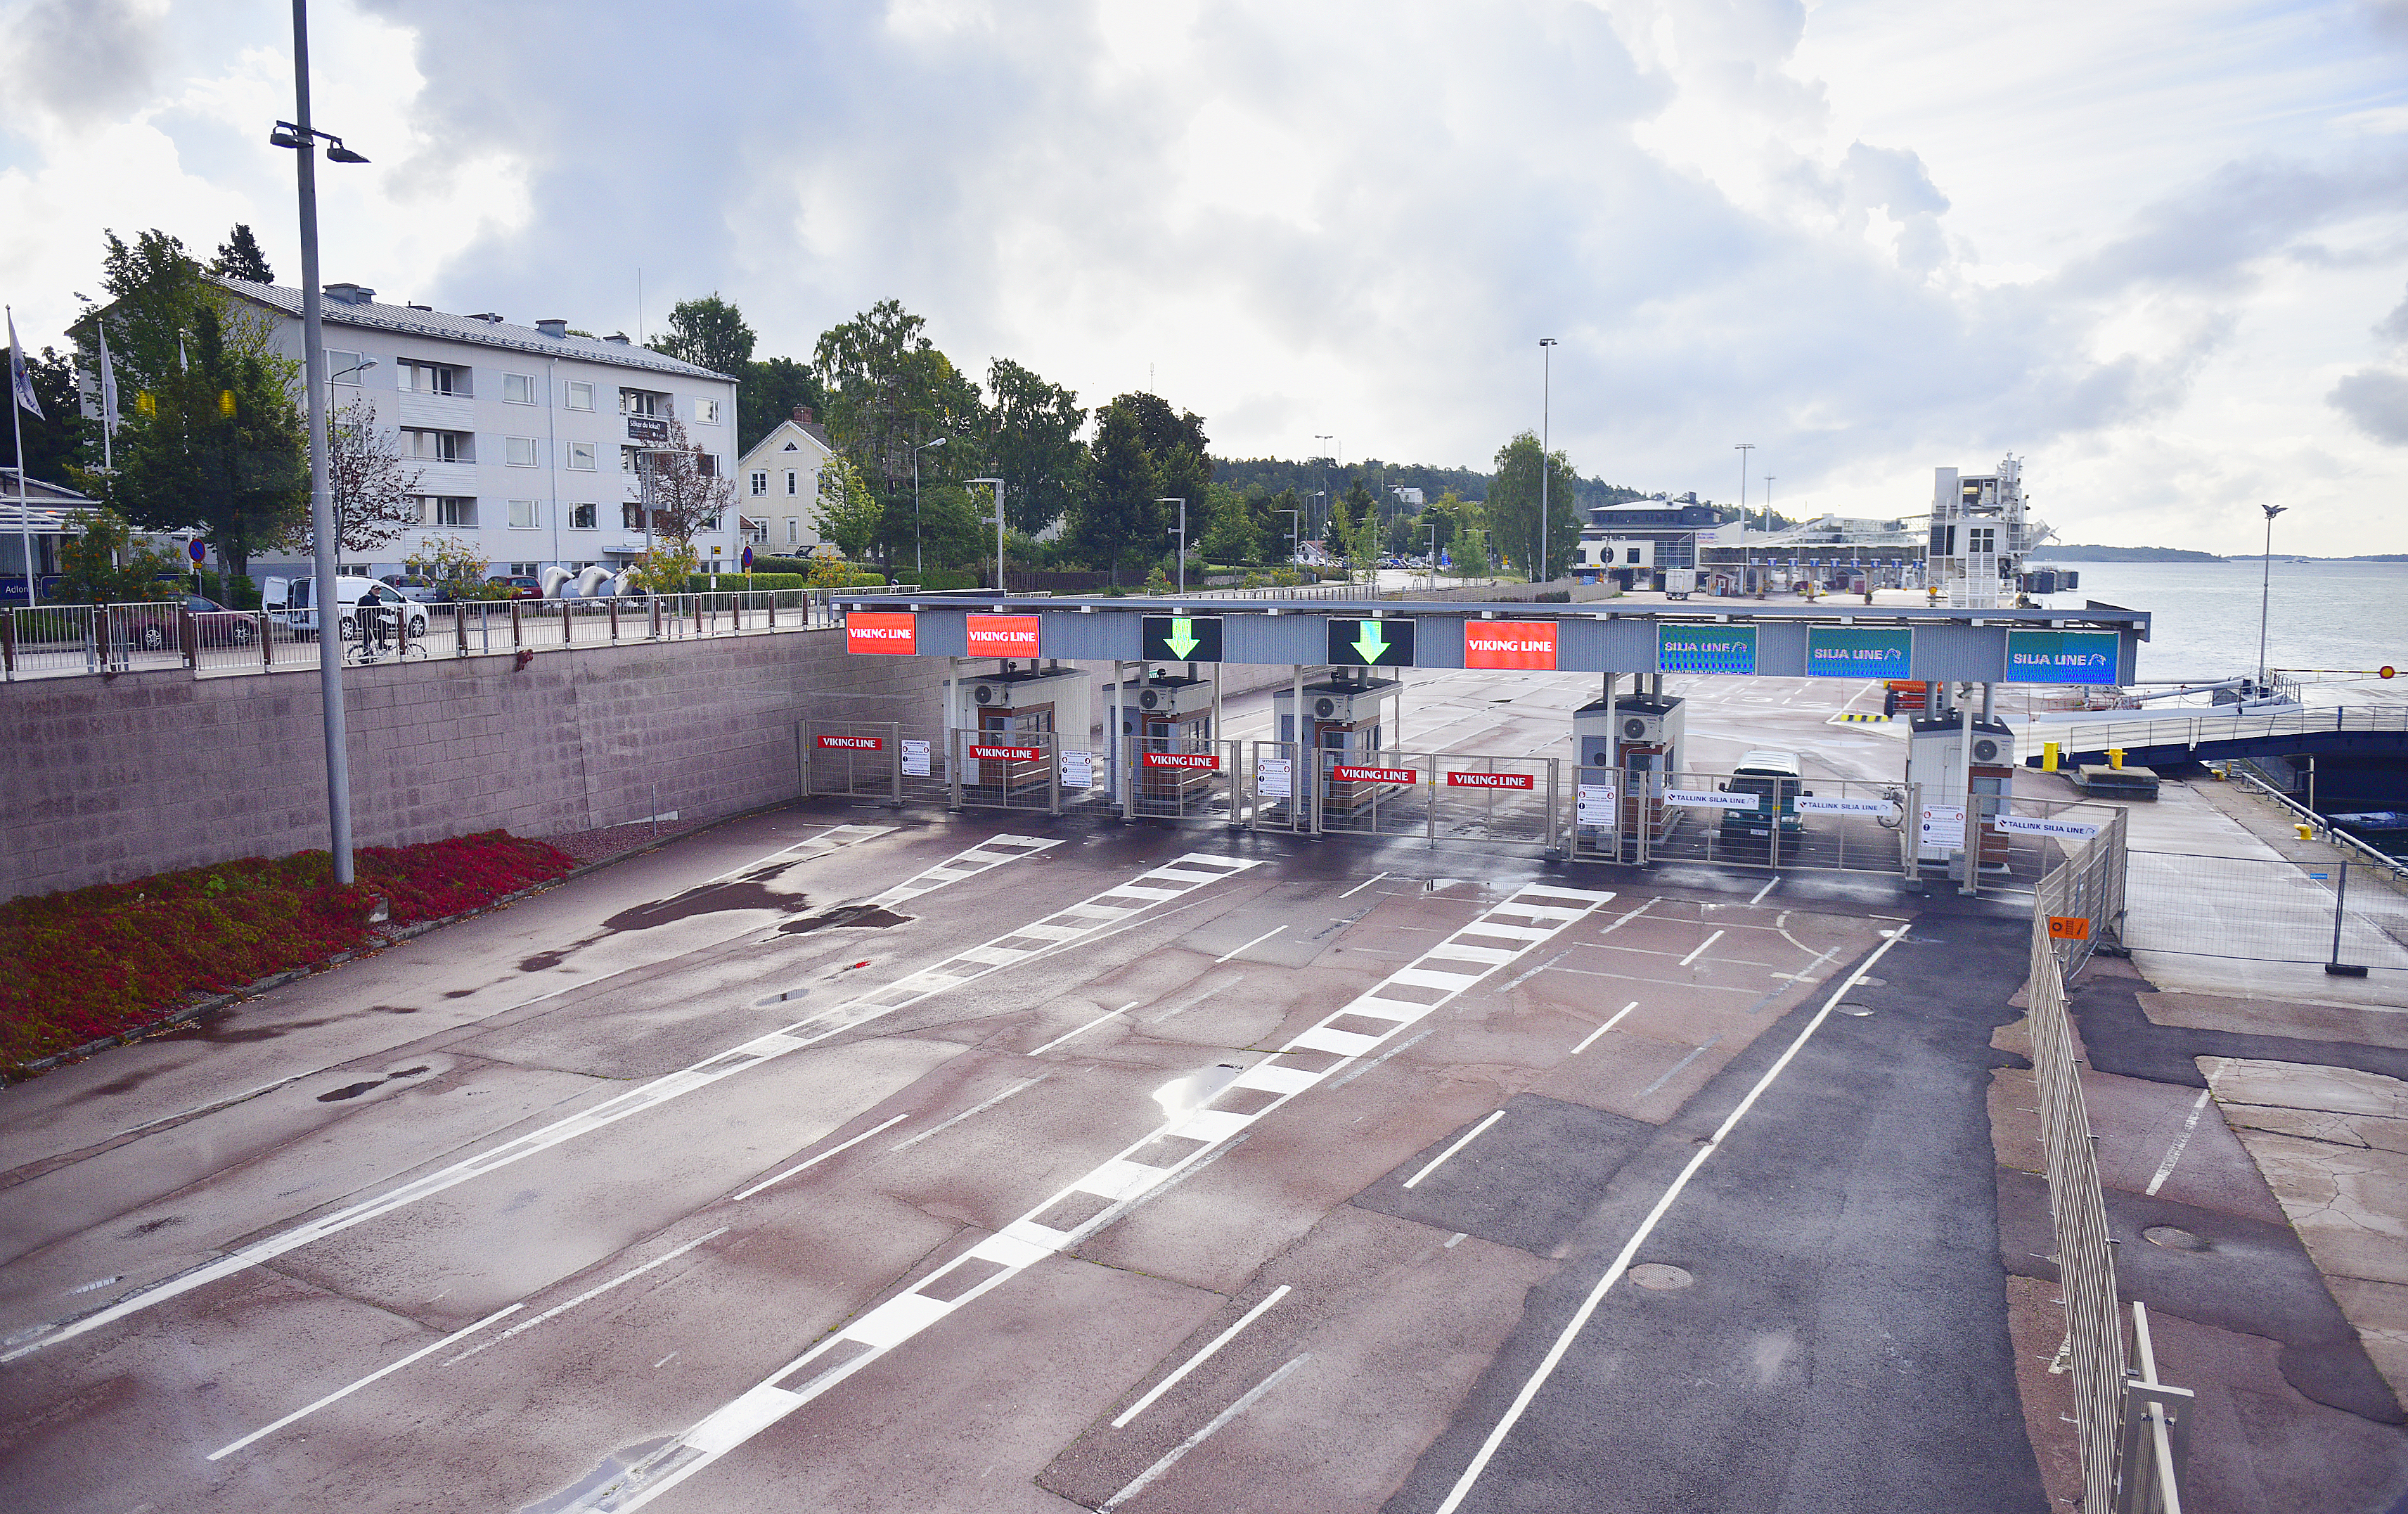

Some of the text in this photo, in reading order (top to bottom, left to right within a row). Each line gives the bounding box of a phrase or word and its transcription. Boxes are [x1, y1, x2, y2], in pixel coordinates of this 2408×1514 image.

[849, 628, 912, 639] VIKING LINE
[969, 631, 1036, 642] VIKING LINE
[1469, 640, 1552, 652] VIKING LINE
[1665, 641, 1730, 652] SILJA LINE
[1814, 648, 1884, 660] SILJA LINE
[2014, 653, 2087, 666] SILJA LINE
[823, 738, 876, 748] VIKING LINE
[975, 748, 1033, 759] VIKING LINE
[1150, 755, 1213, 766] VIKING LINE
[1341, 769, 1409, 781] VIKING LINE
[1455, 774, 1526, 787] VIKING LINE
[2009, 821, 2041, 830] TALLINK
